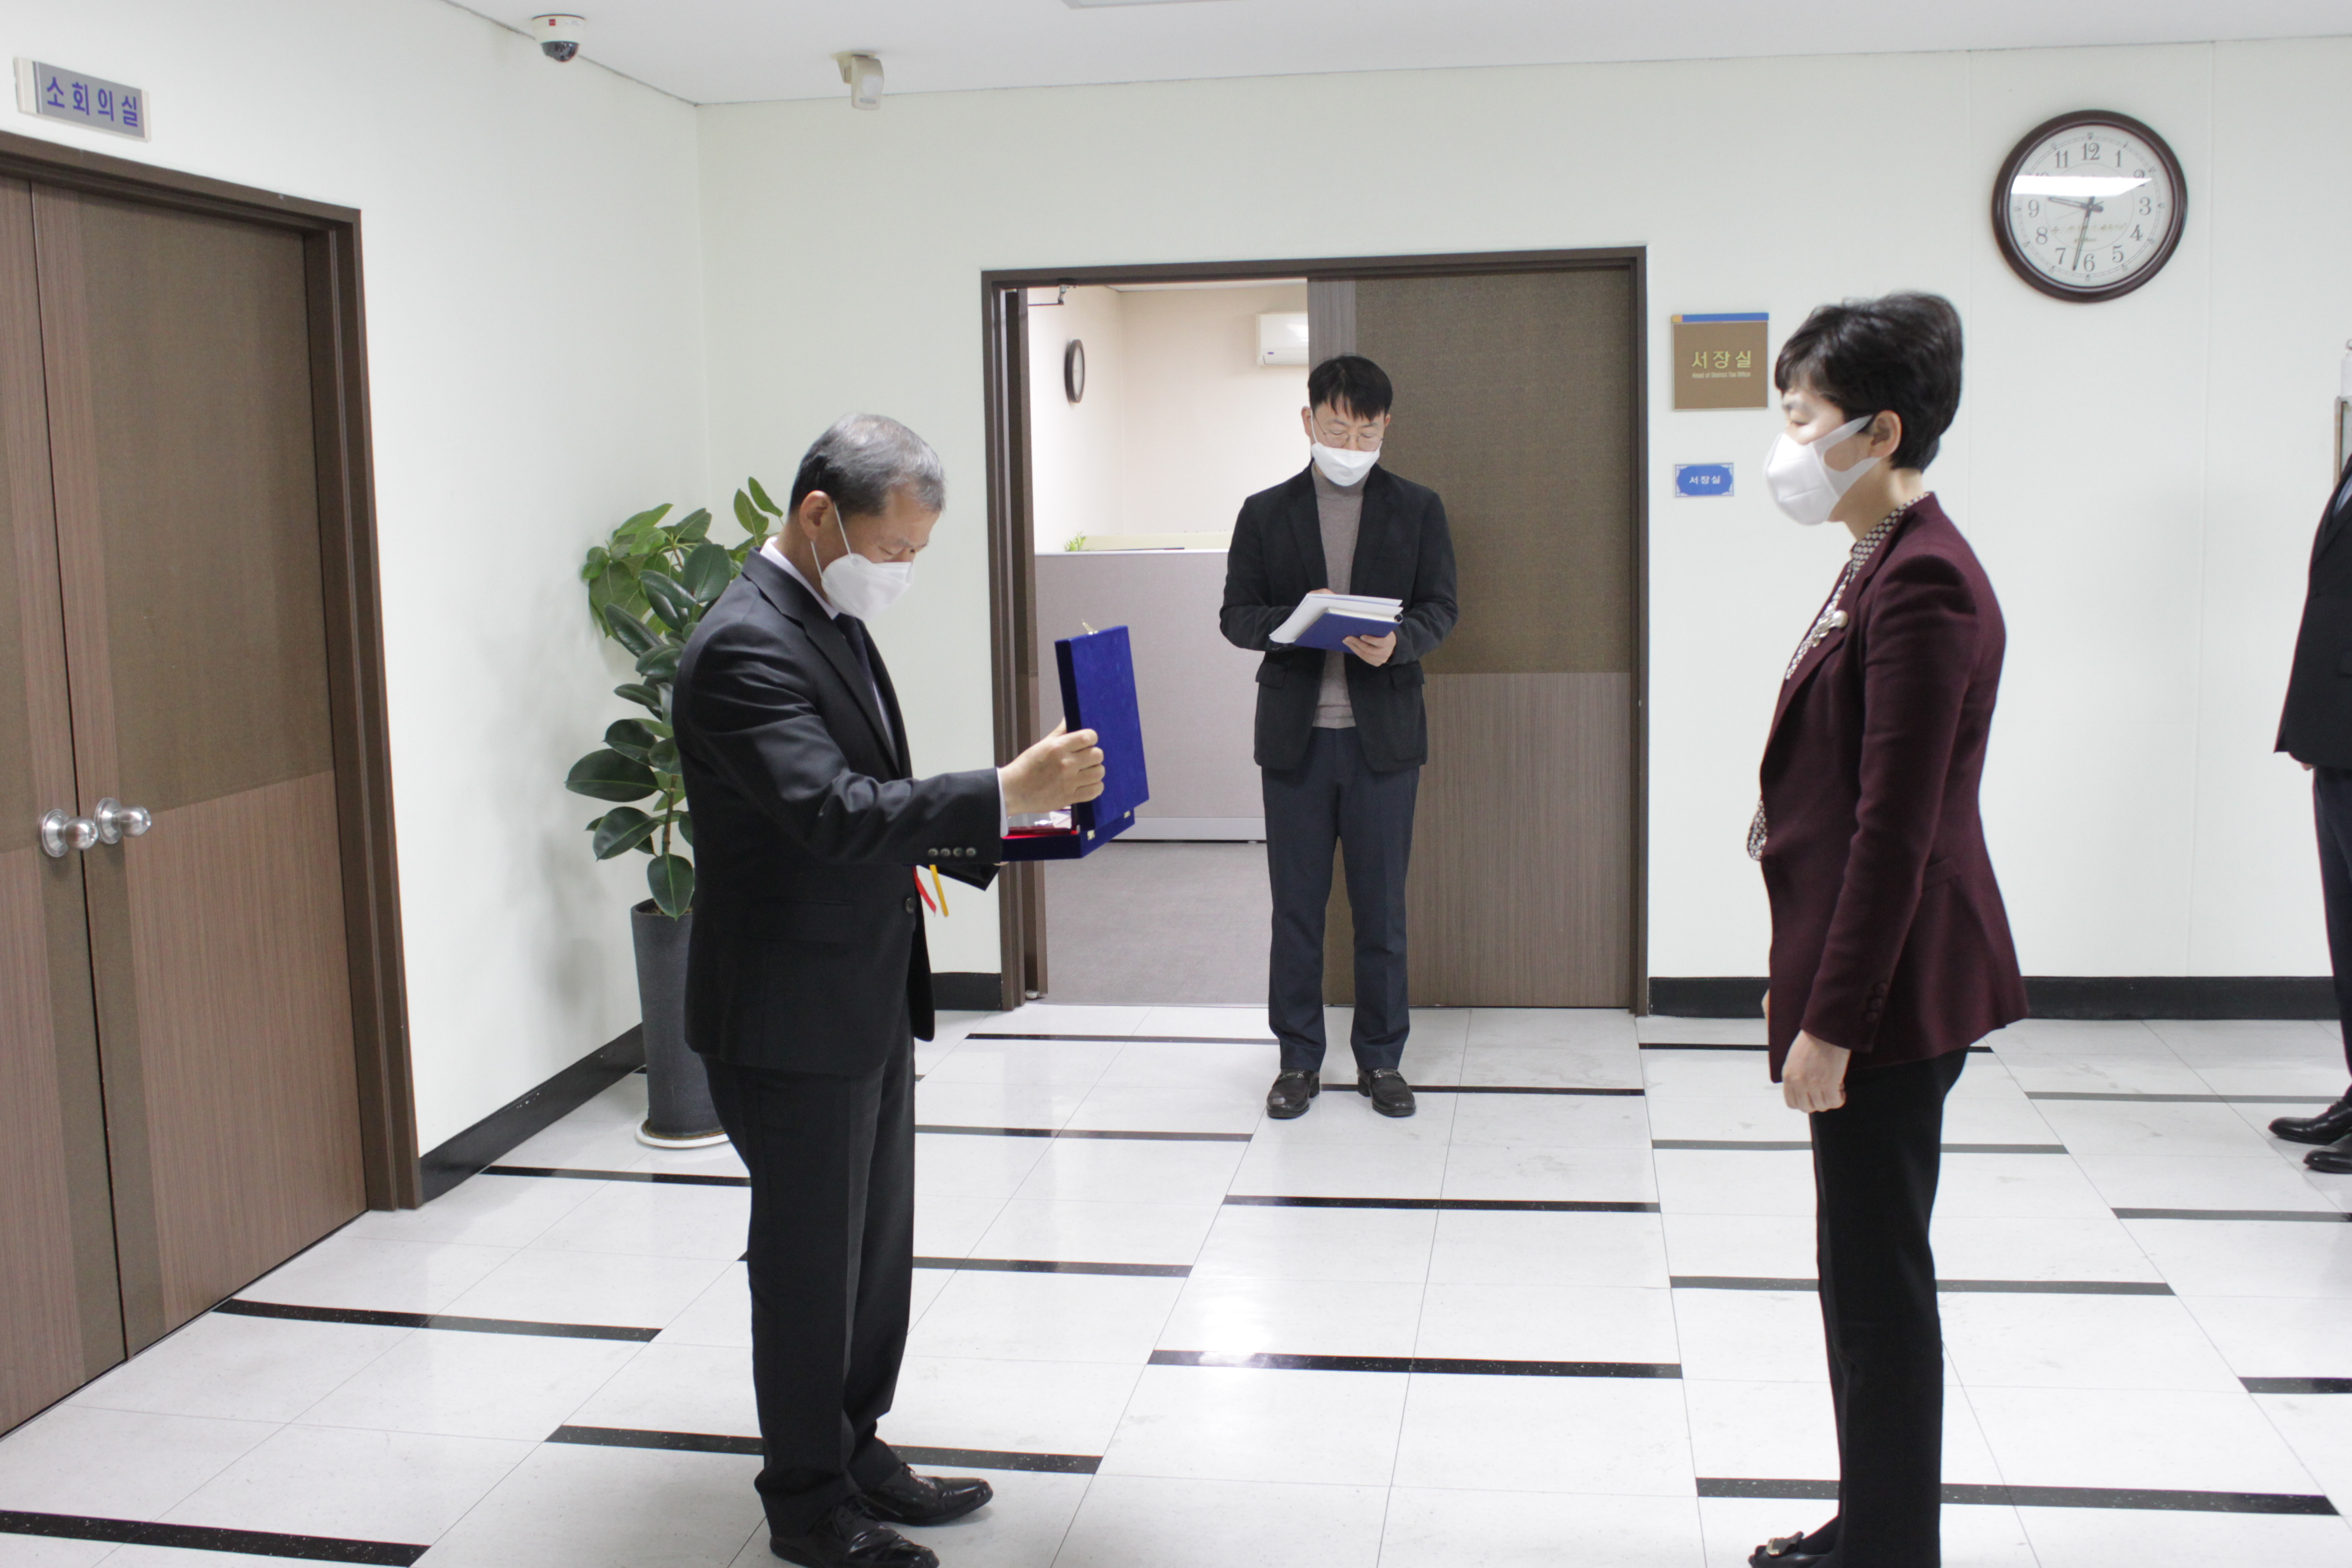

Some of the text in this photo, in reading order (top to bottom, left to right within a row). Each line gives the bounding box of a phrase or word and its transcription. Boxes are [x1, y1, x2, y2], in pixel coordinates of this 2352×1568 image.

[47, 76, 138, 127] 소회의실
[2055, 150, 2069, 168] 11
[2082, 142, 2100, 160] 12
[2115, 149, 2121, 168] 1
[2028, 199, 2040, 218] 9
[2139, 197, 2151, 216] 3
[2036, 227, 2048, 245] 8
[2129, 224, 2143, 242] 4
[2055, 247, 2067, 265] 7
[2083, 253, 2095, 272] 6
[2112, 244, 2124, 263] 5
[1691, 350, 1752, 369] 서장실
[1689, 475, 1721, 485] 서장실
